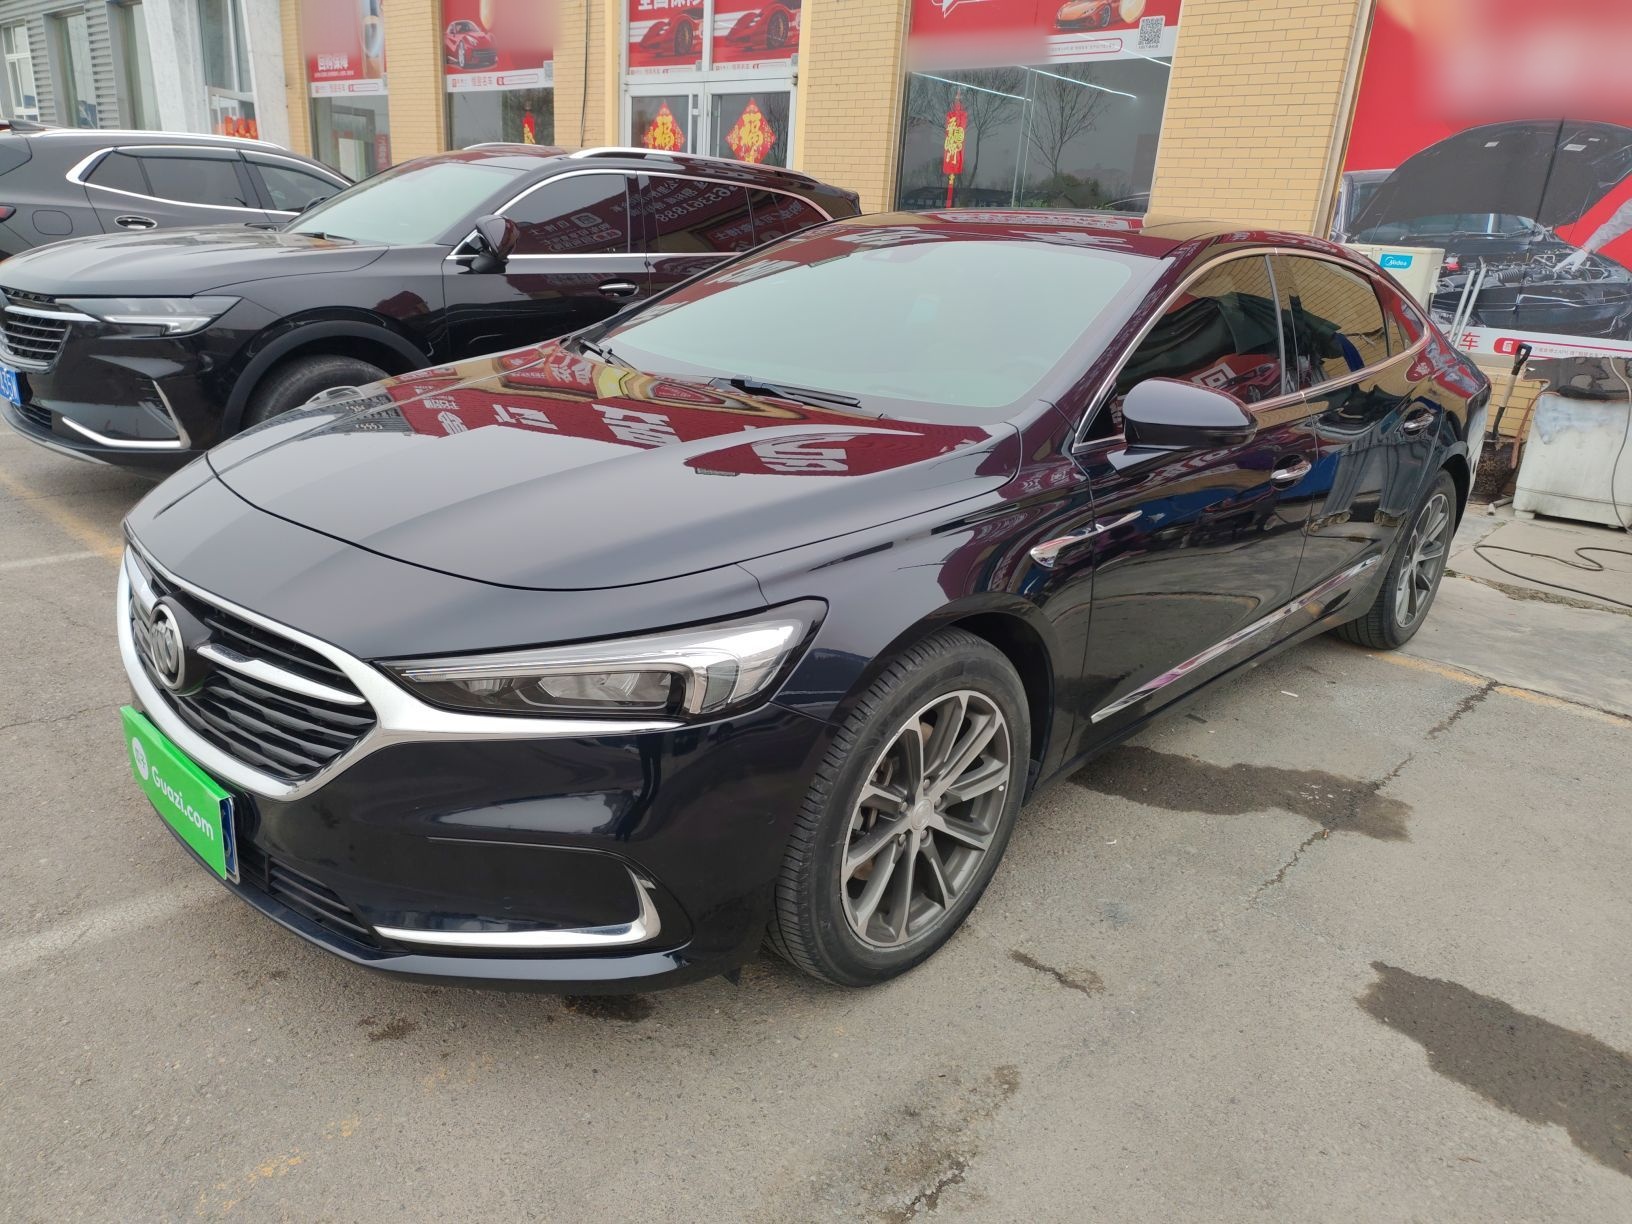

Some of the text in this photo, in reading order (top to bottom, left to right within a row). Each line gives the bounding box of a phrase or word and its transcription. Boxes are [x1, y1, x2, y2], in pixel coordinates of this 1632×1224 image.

[740, 113, 763, 147] 福
[1460, 332, 1480, 351] 车
[151, 766, 214, 841] Guazi.com
